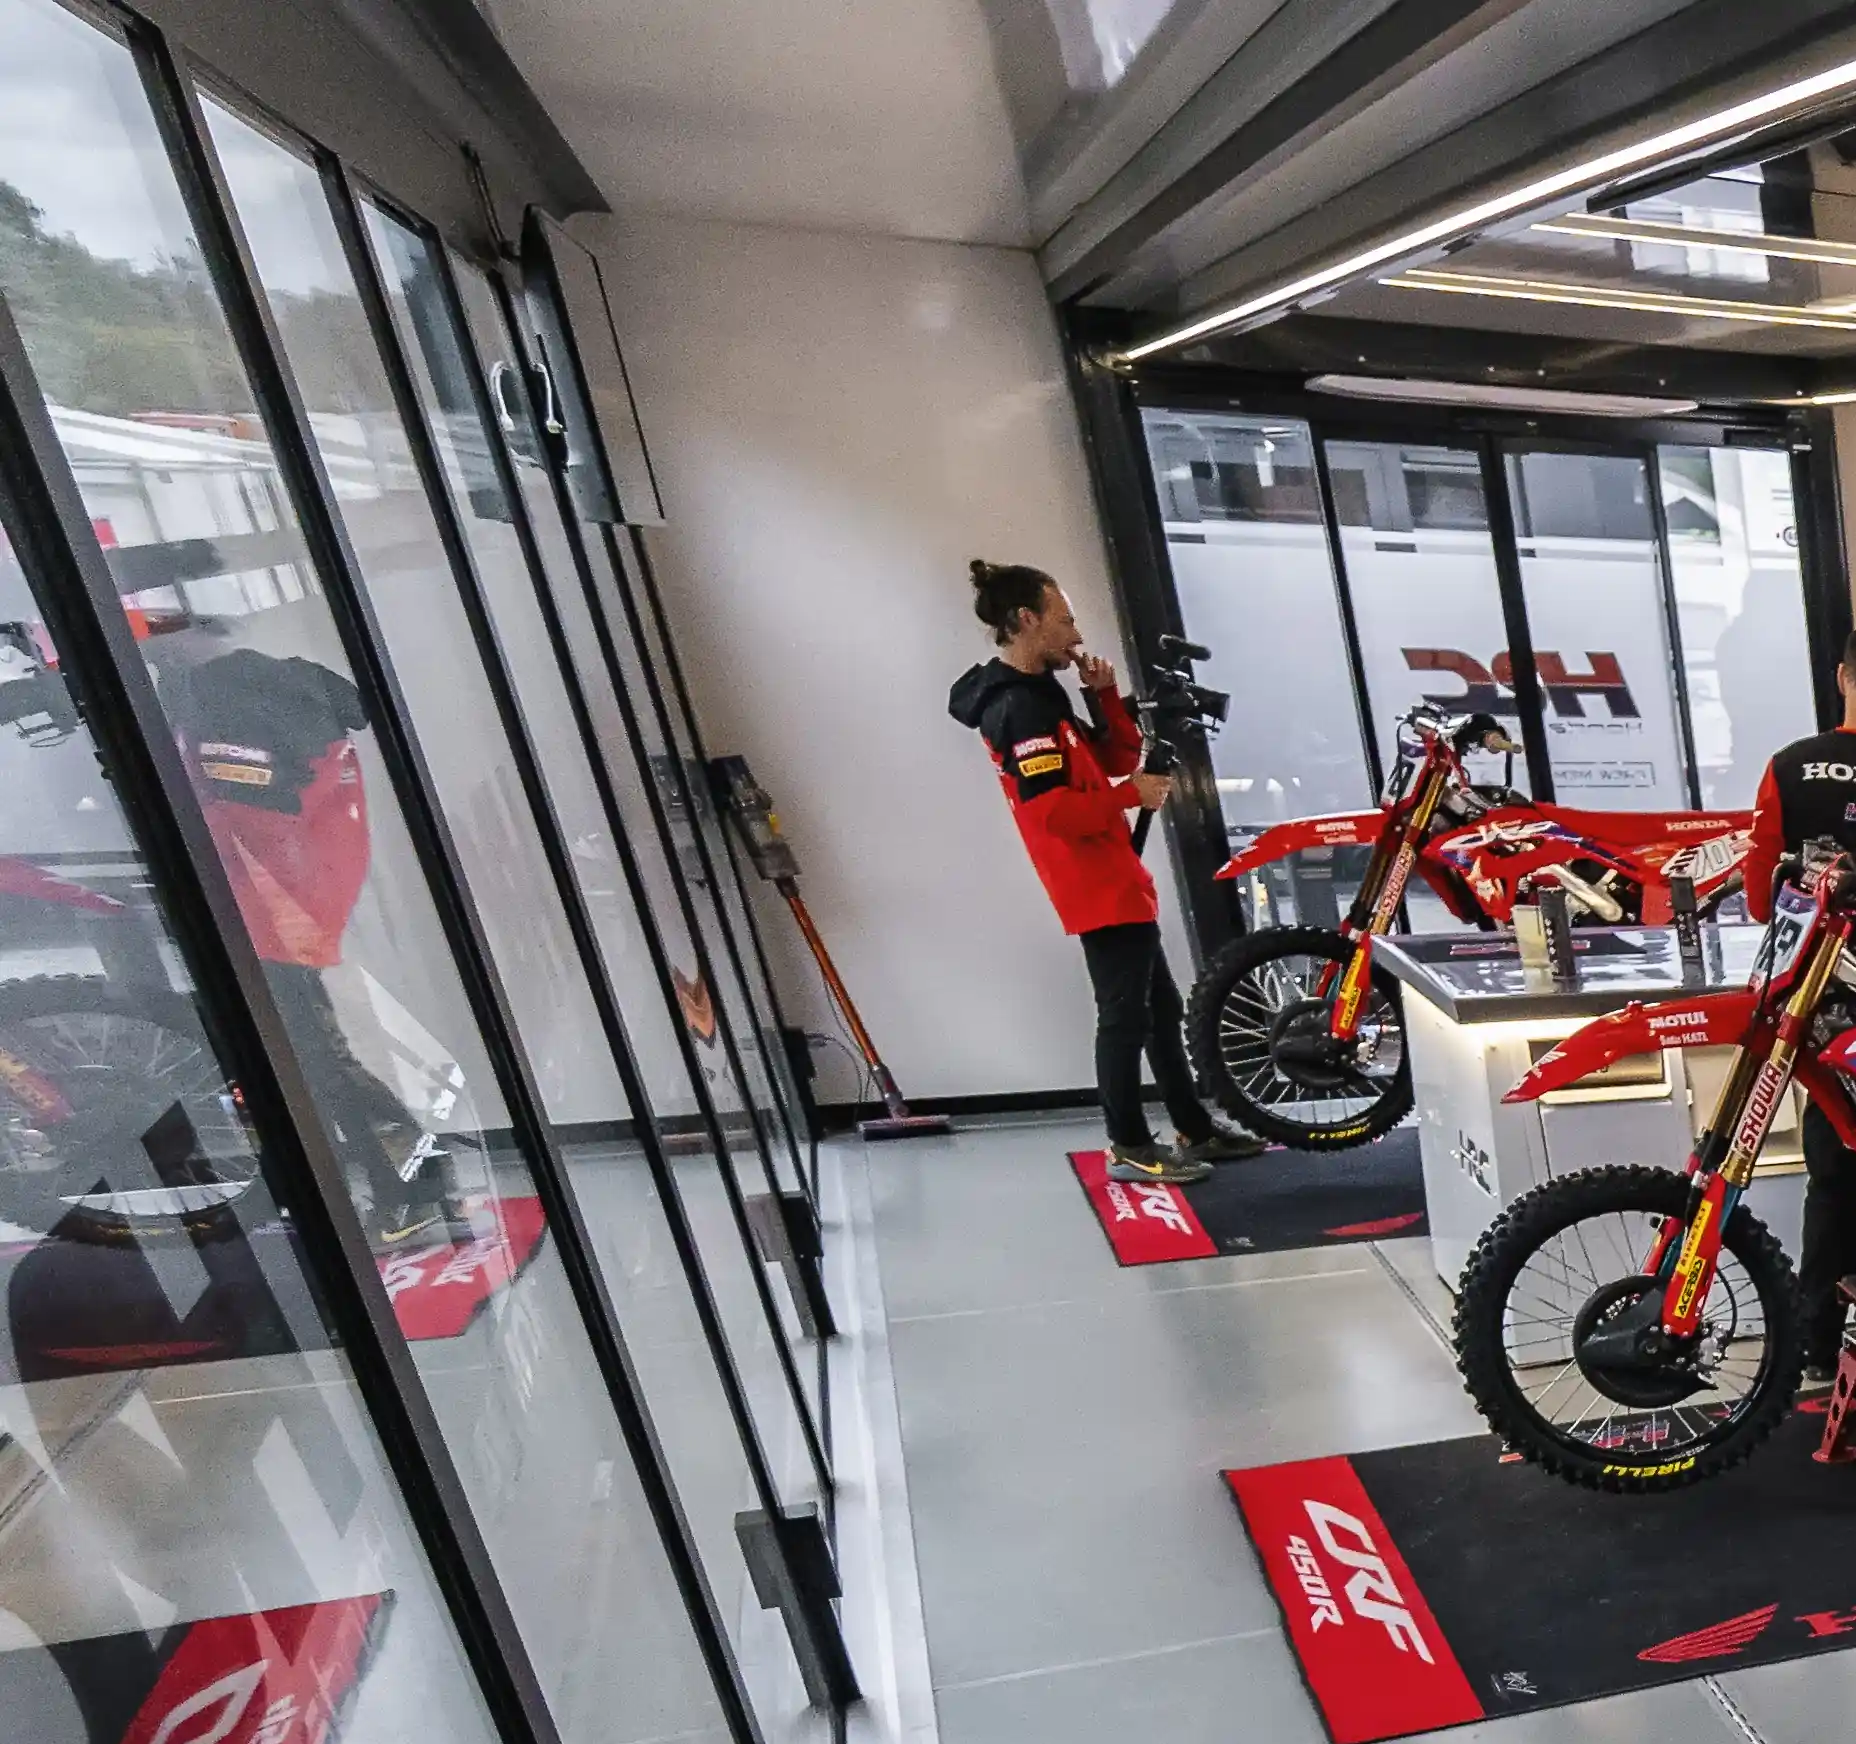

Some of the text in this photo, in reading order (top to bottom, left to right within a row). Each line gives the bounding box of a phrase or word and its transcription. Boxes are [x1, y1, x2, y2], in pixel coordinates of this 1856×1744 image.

[1648, 1012, 1708, 1028] MOTUL
[1738, 1062, 1783, 1150] SHOWA
[1678, 1259, 1703, 1316] ACERBIS
[1603, 1456, 1696, 1477] PIRELLI
[1285, 1535, 1344, 1633] 450R
[1303, 1500, 1435, 1665] CRF
